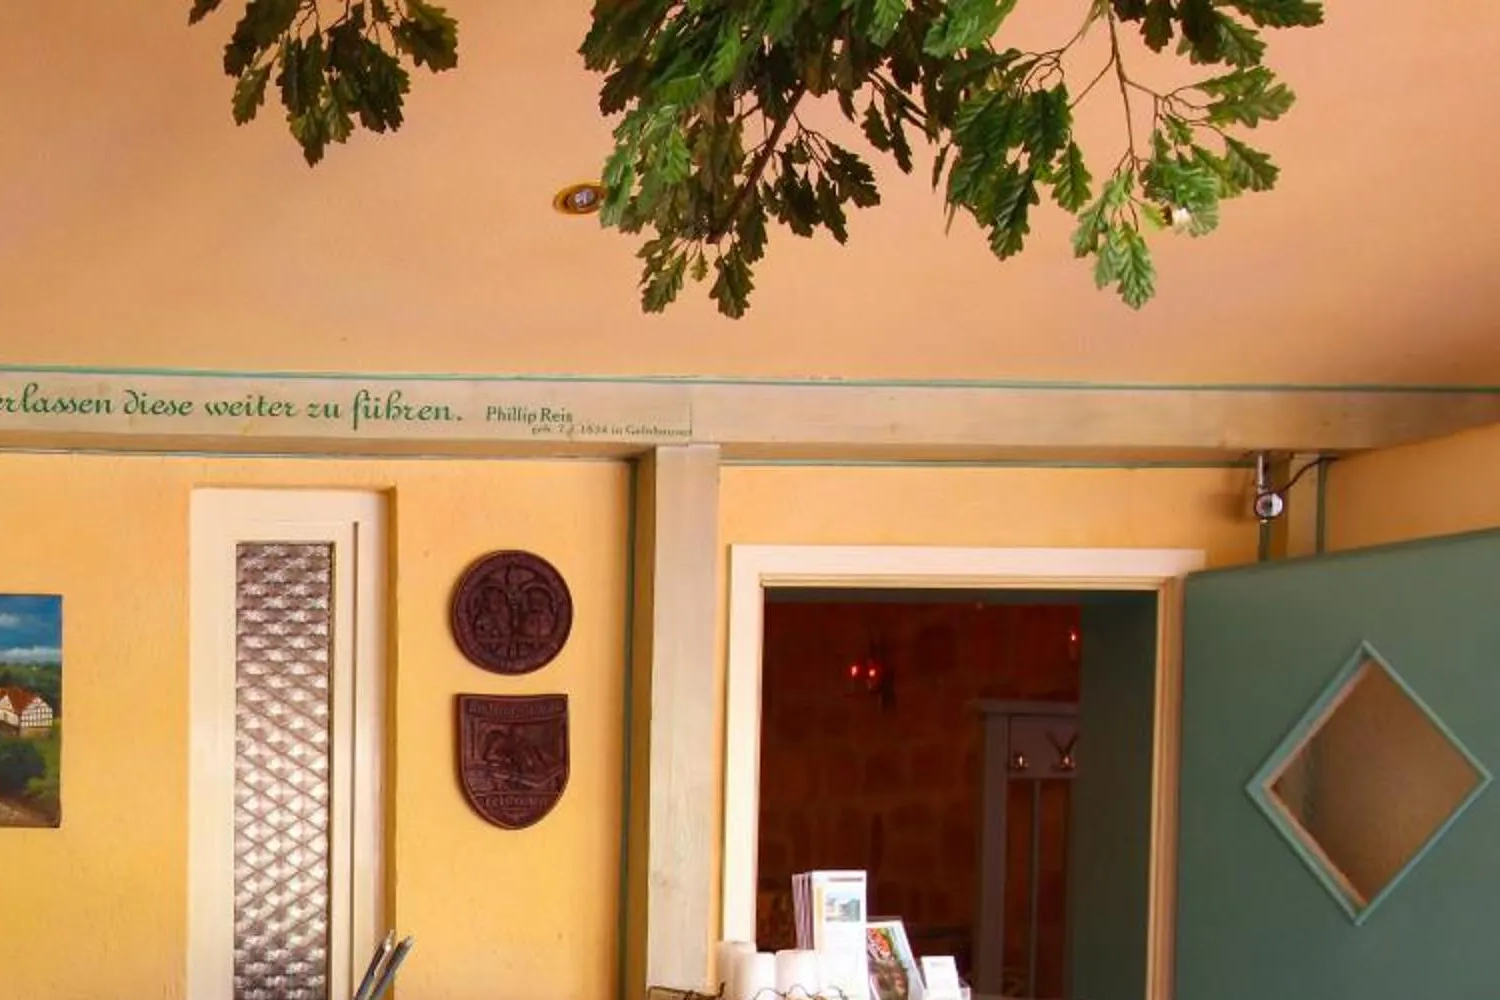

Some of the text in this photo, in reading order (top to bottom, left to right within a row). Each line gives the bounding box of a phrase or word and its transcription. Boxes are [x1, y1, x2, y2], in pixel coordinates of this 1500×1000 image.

[123, 389, 194, 416] diese
[204, 394, 298, 418] weiter
[307, 403, 342, 419] zu
[486, 405, 573, 425] Phillip Reis
